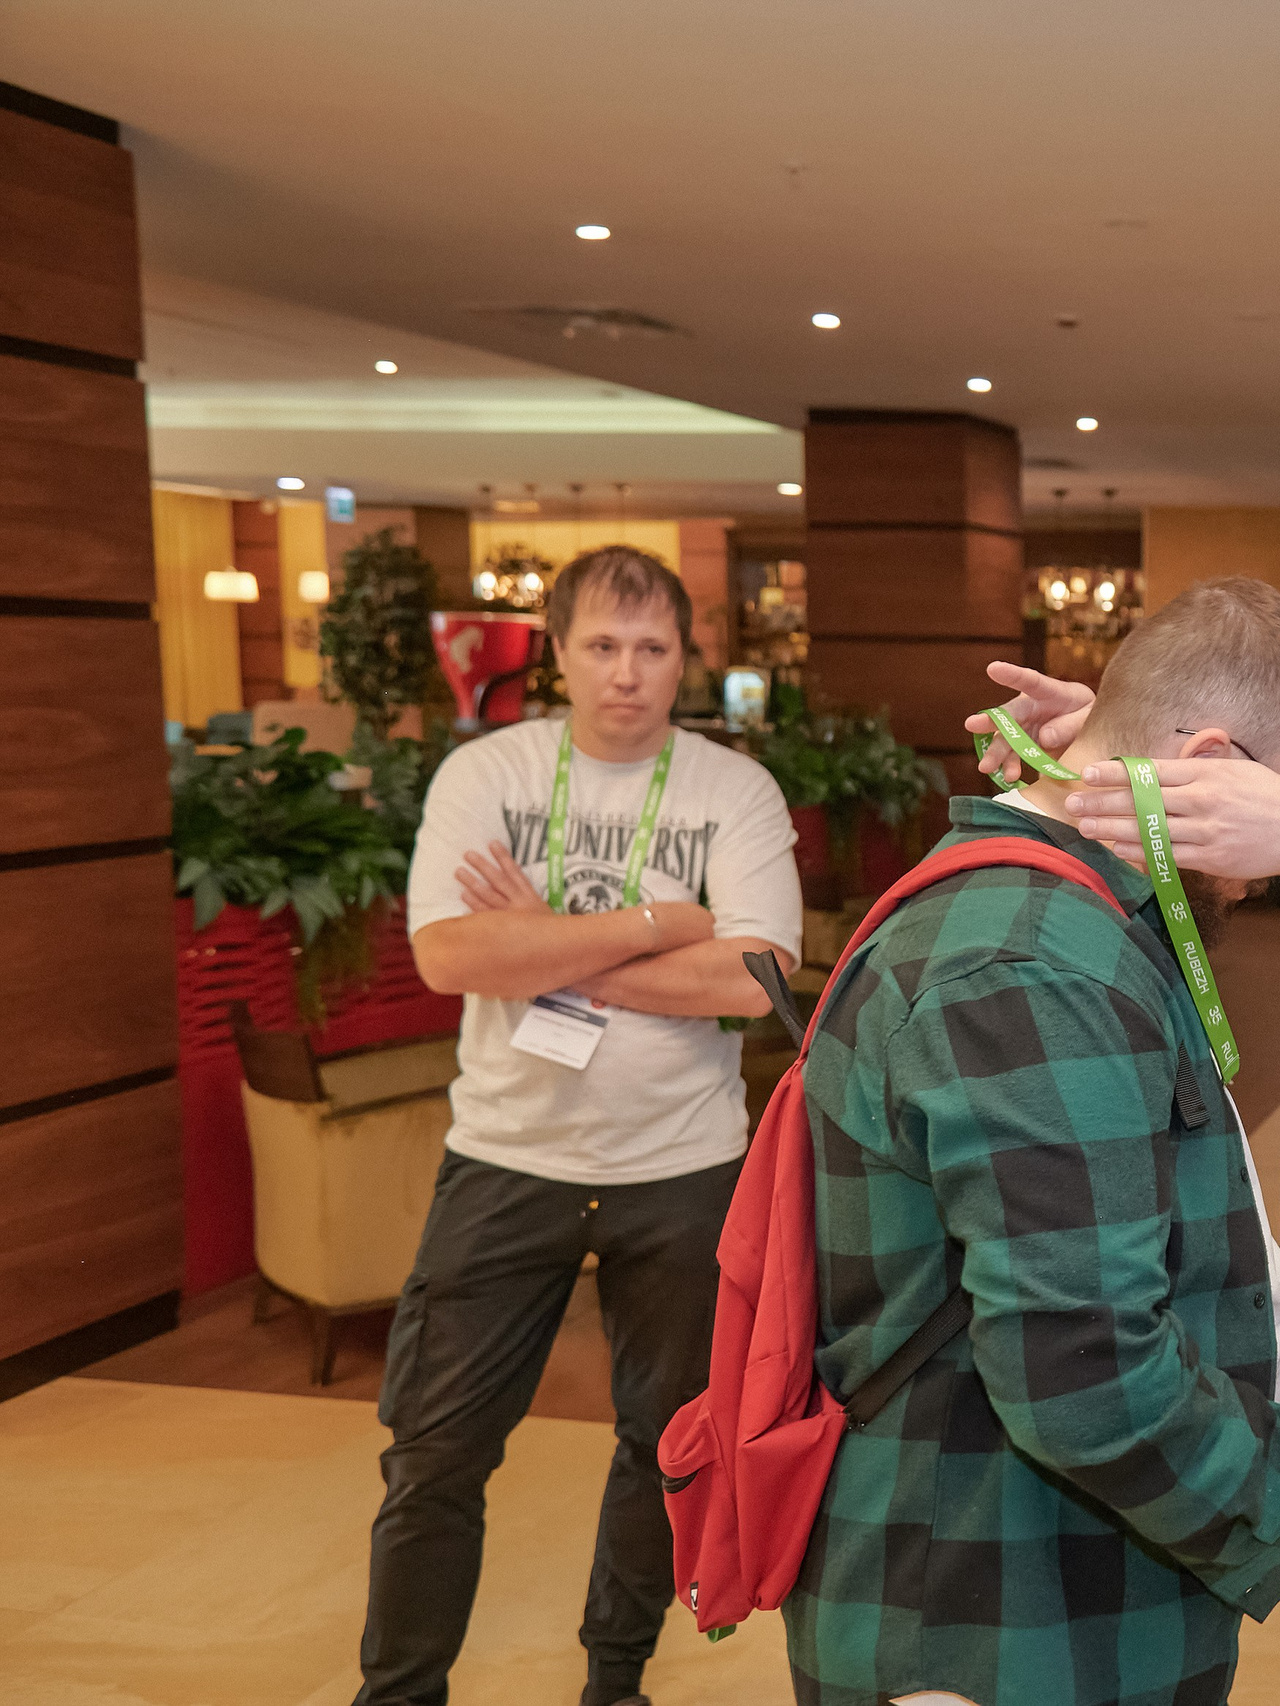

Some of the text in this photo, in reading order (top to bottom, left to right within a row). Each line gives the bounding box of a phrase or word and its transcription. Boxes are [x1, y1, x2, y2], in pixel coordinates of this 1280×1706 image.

[1137, 763, 1154, 785] 35
[1146, 813, 1172, 883] RUBEZH
[1171, 901, 1188, 921] 35
[1183, 940, 1210, 995] RUBEZH
[1209, 1005, 1223, 1026] 35
